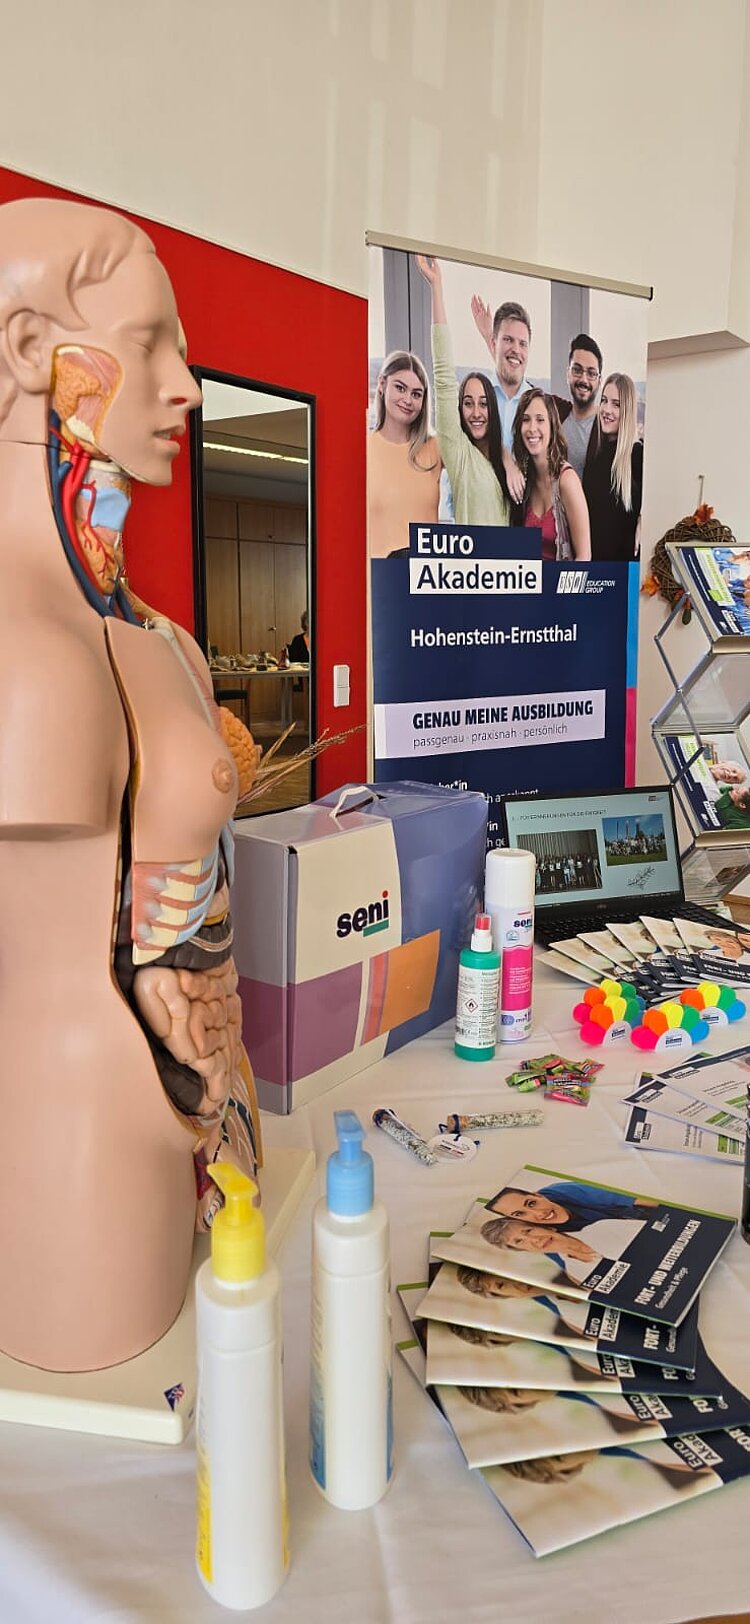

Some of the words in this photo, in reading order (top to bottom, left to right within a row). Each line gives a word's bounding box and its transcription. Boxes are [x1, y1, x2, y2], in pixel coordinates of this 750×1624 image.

[417, 527, 474, 555] Euro
[416, 564, 537, 590] Akademie
[410, 624, 578, 648] Hohenstein-Ernstthal
[412, 711, 461, 730] GENAU
[464, 706, 508, 726] MEINE
[511, 700, 594, 721] AUSBILDUNG
[413, 735, 465, 749] passgenau
[471, 729, 517, 744] praxisnah
[523, 723, 568, 739] persönlich
[336, 890, 389, 938] seni
[583, 1274, 603, 1289] Euro
[598, 1263, 628, 1293] Akademie
[585, 1317, 601, 1336] Euro
[629, 1395, 651, 1420] Euro
[673, 1441, 702, 1468] Euro
